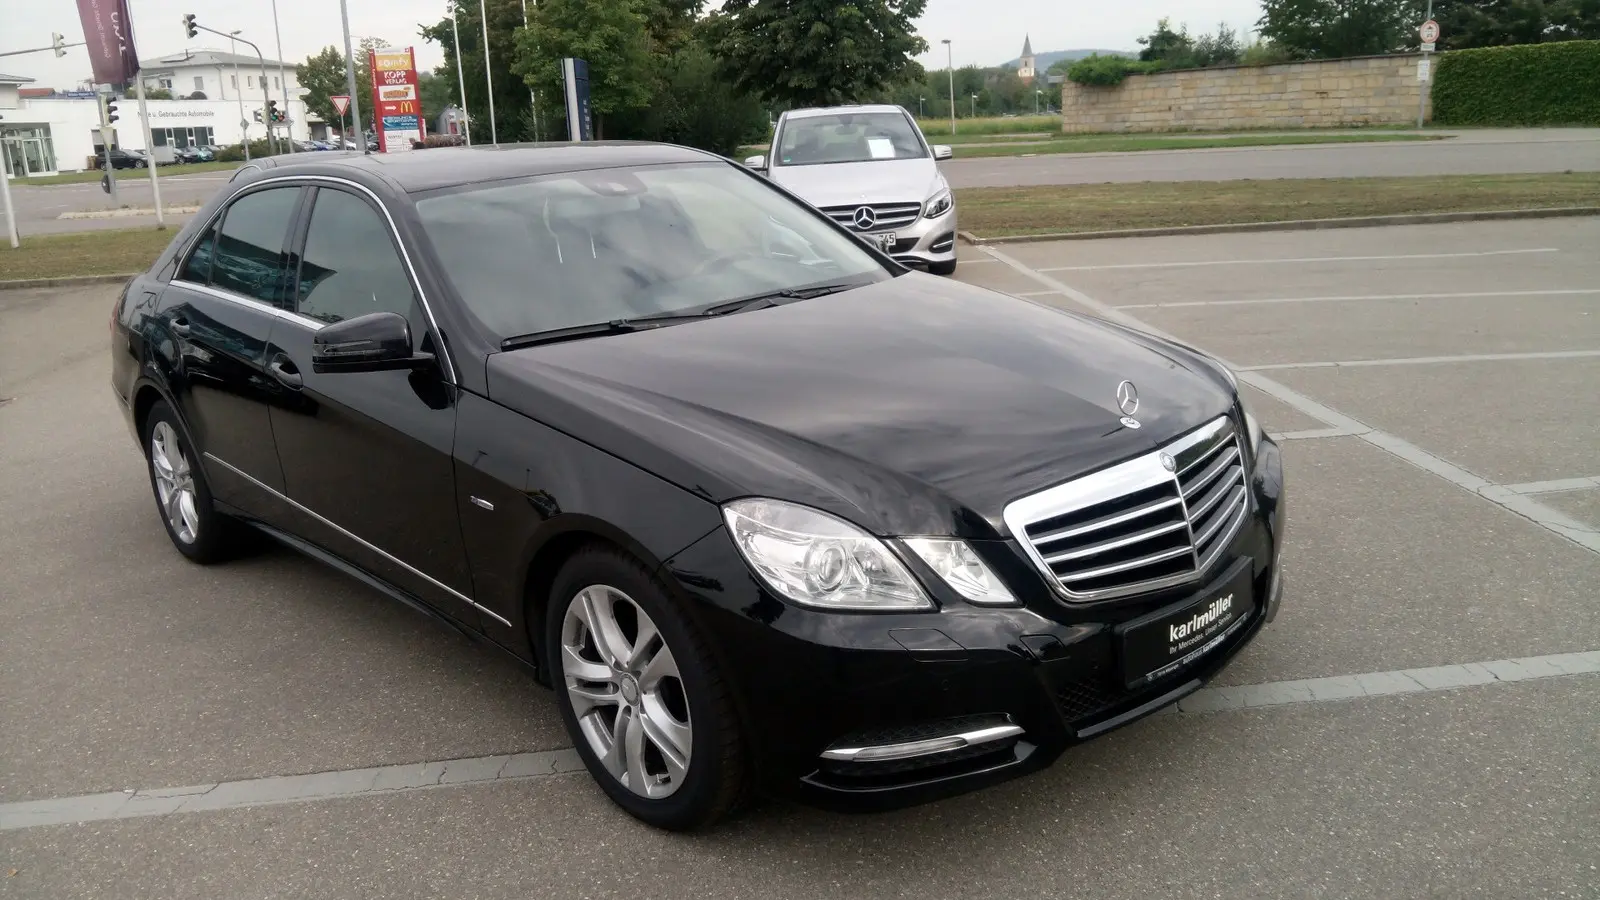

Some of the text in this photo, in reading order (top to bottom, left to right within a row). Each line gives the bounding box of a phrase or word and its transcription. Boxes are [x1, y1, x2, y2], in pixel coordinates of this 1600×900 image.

[384, 70, 406, 79] KOPP
[159, 110, 187, 118] Gebrauchte
[1169, 593, 1233, 642] karlmüller
[1169, 645, 1177, 655] Ihr
